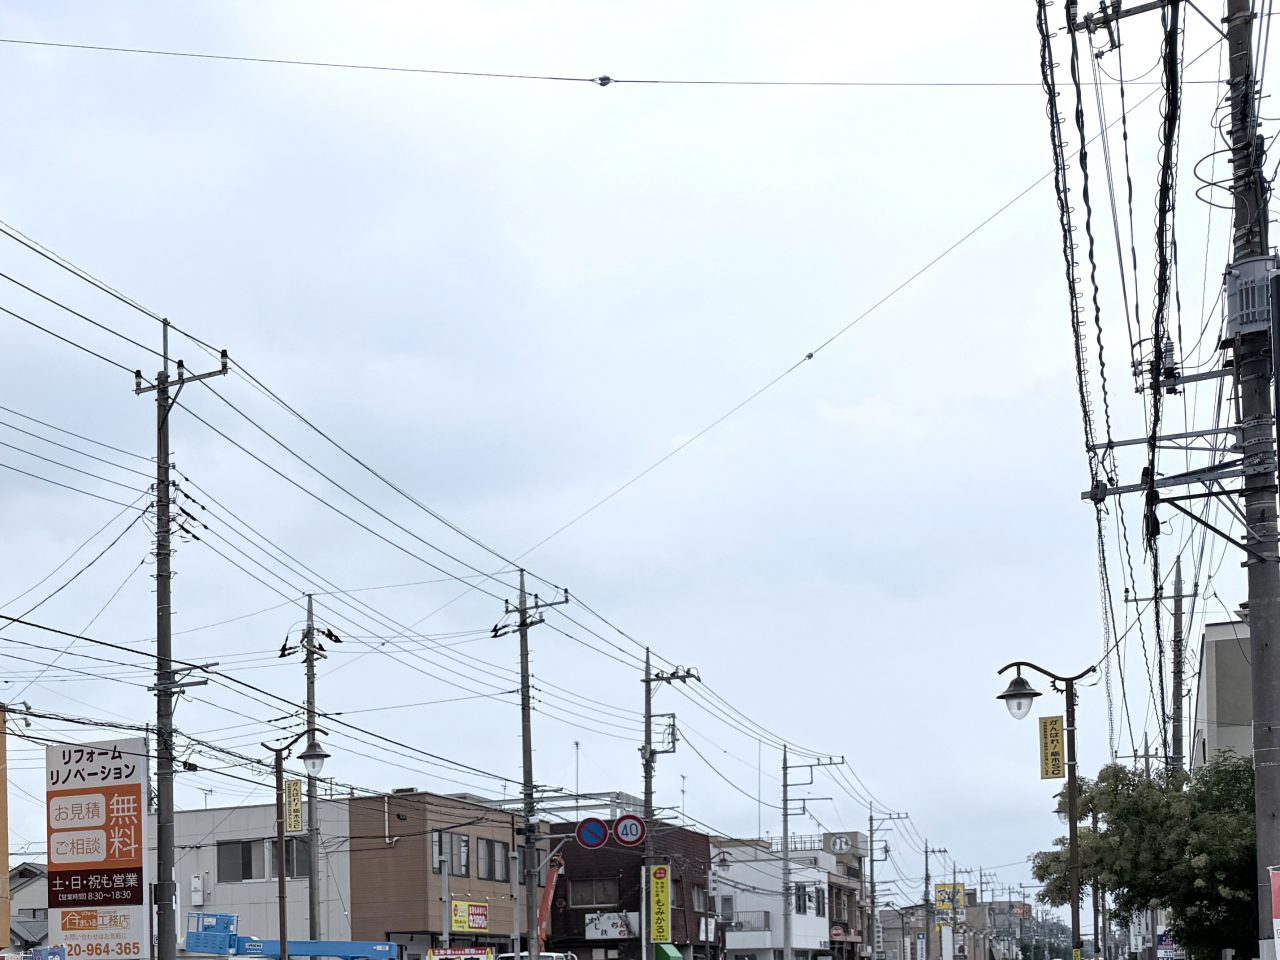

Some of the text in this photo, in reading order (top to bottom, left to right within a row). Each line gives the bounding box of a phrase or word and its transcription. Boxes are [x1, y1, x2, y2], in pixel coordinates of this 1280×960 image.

[62, 744, 122, 766] リフォーム
[51, 763, 136, 786] リノベーション
[54, 800, 101, 822] お見積
[109, 793, 139, 859] 無料
[620, 823, 639, 838] 40
[55, 837, 101, 856] ご相談
[53, 942, 140, 957] 20-964-365
